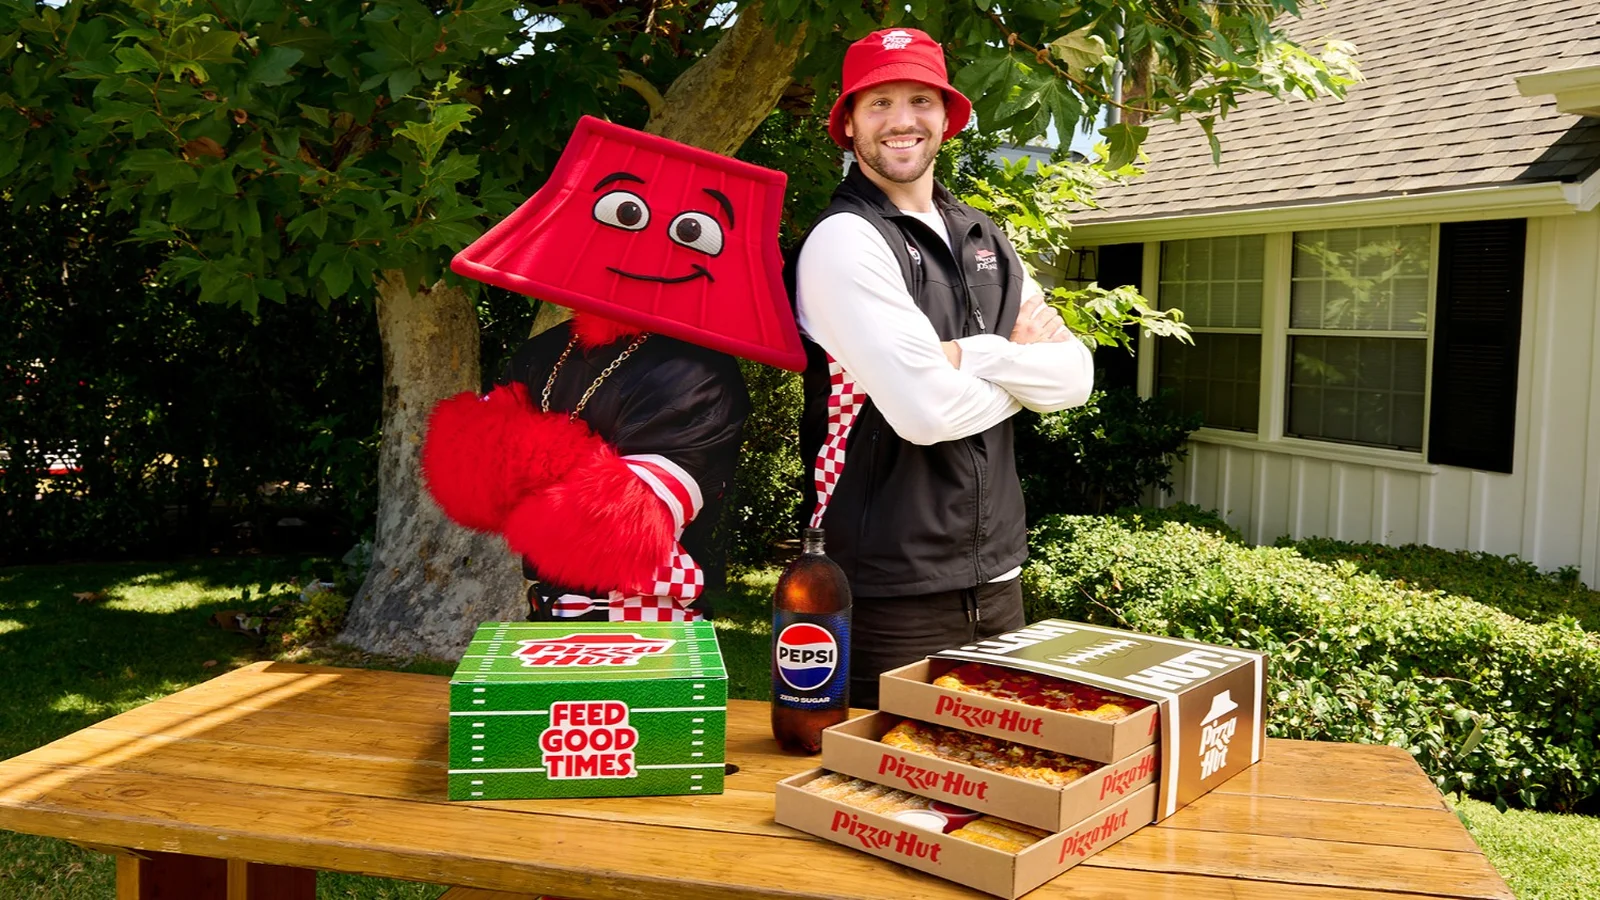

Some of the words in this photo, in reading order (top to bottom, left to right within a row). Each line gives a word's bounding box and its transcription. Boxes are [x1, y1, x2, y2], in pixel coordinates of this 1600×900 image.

[522, 644, 663, 657] Pizza
[527, 655, 635, 665] Hut
[779, 646, 834, 664] PEPSI
[1125, 649, 1241, 690] HUT!
[553, 703, 626, 727] FEED
[780, 694, 800, 703] ZERO
[800, 696, 831, 704] SUGAR
[935, 694, 996, 728] Pizza
[996, 708, 1043, 736] Hut
[541, 728, 636, 753] GOOD
[1199, 717, 1237, 756] Pizza
[545, 753, 632, 778] TIMES
[878, 752, 939, 790] Pizza
[940, 770, 988, 800] Hut
[1201, 746, 1228, 780] Hut
[1100, 766, 1136, 801] Pizza
[831, 809, 892, 849] Pizza
[893, 830, 941, 863] Hut
[1058, 827, 1099, 864] Pizza
[1100, 808, 1128, 841] Hut
